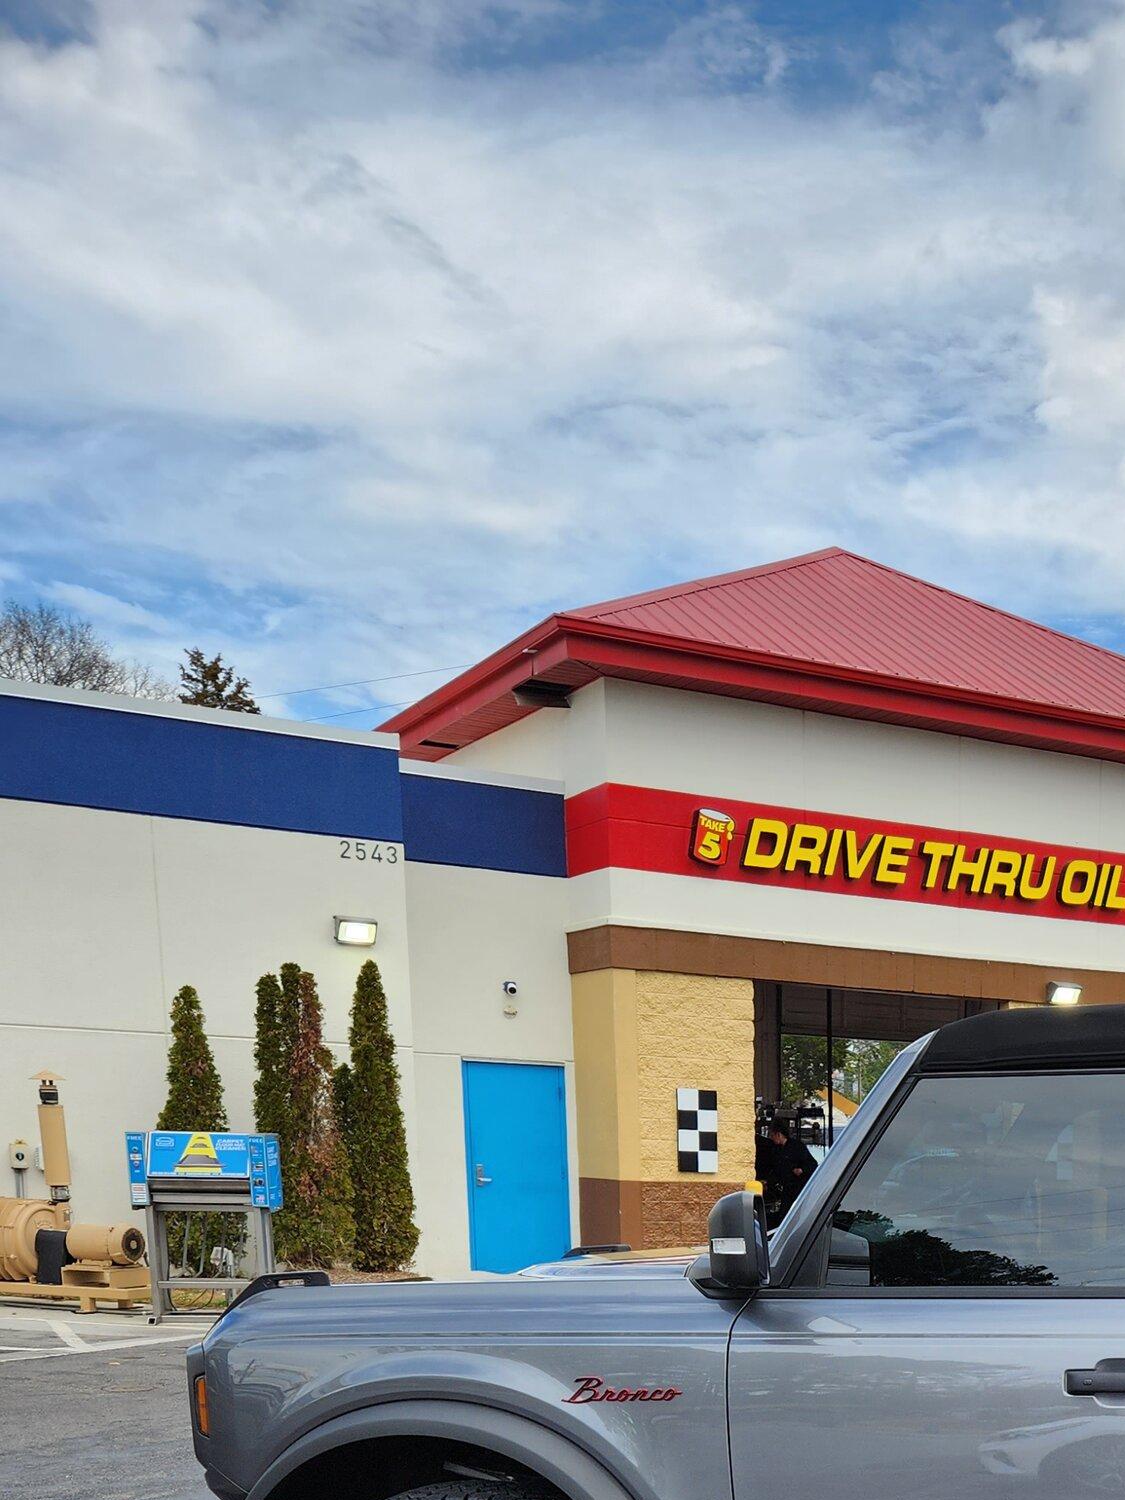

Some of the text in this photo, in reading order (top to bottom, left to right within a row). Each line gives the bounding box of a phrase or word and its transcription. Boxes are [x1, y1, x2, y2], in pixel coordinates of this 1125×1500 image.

[699, 814, 727, 832] TAKE
[340, 840, 398, 864] 2543
[698, 831, 721, 859] 5
[743, 817, 915, 884] DRIVE
[922, 840, 1057, 900] THRU
[560, 1376, 683, 1404] Bronco
